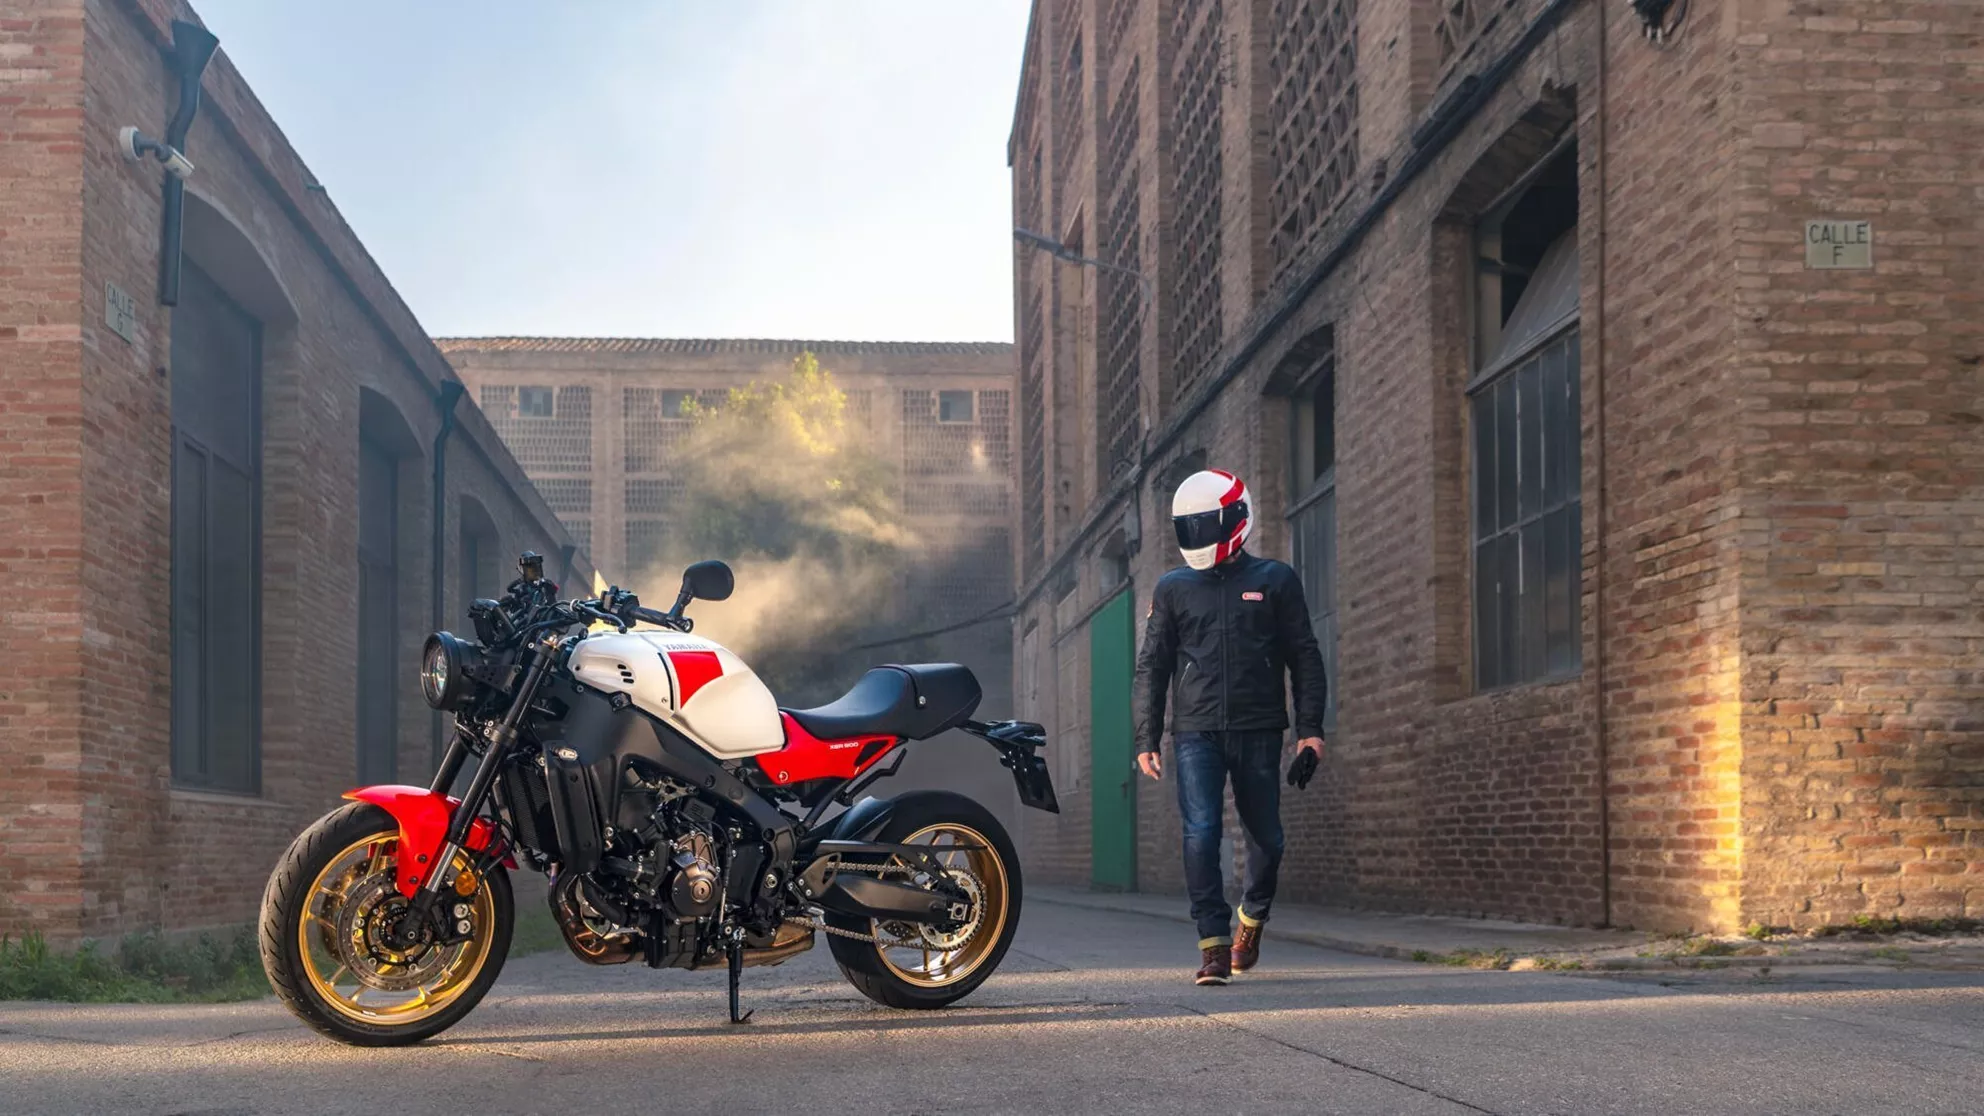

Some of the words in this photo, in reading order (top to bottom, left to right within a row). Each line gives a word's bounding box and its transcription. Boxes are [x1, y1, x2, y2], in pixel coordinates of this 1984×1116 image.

[1809, 224, 1868, 244] CALLE
[1832, 245, 1844, 265] F
[107, 283, 133, 319] CALLE
